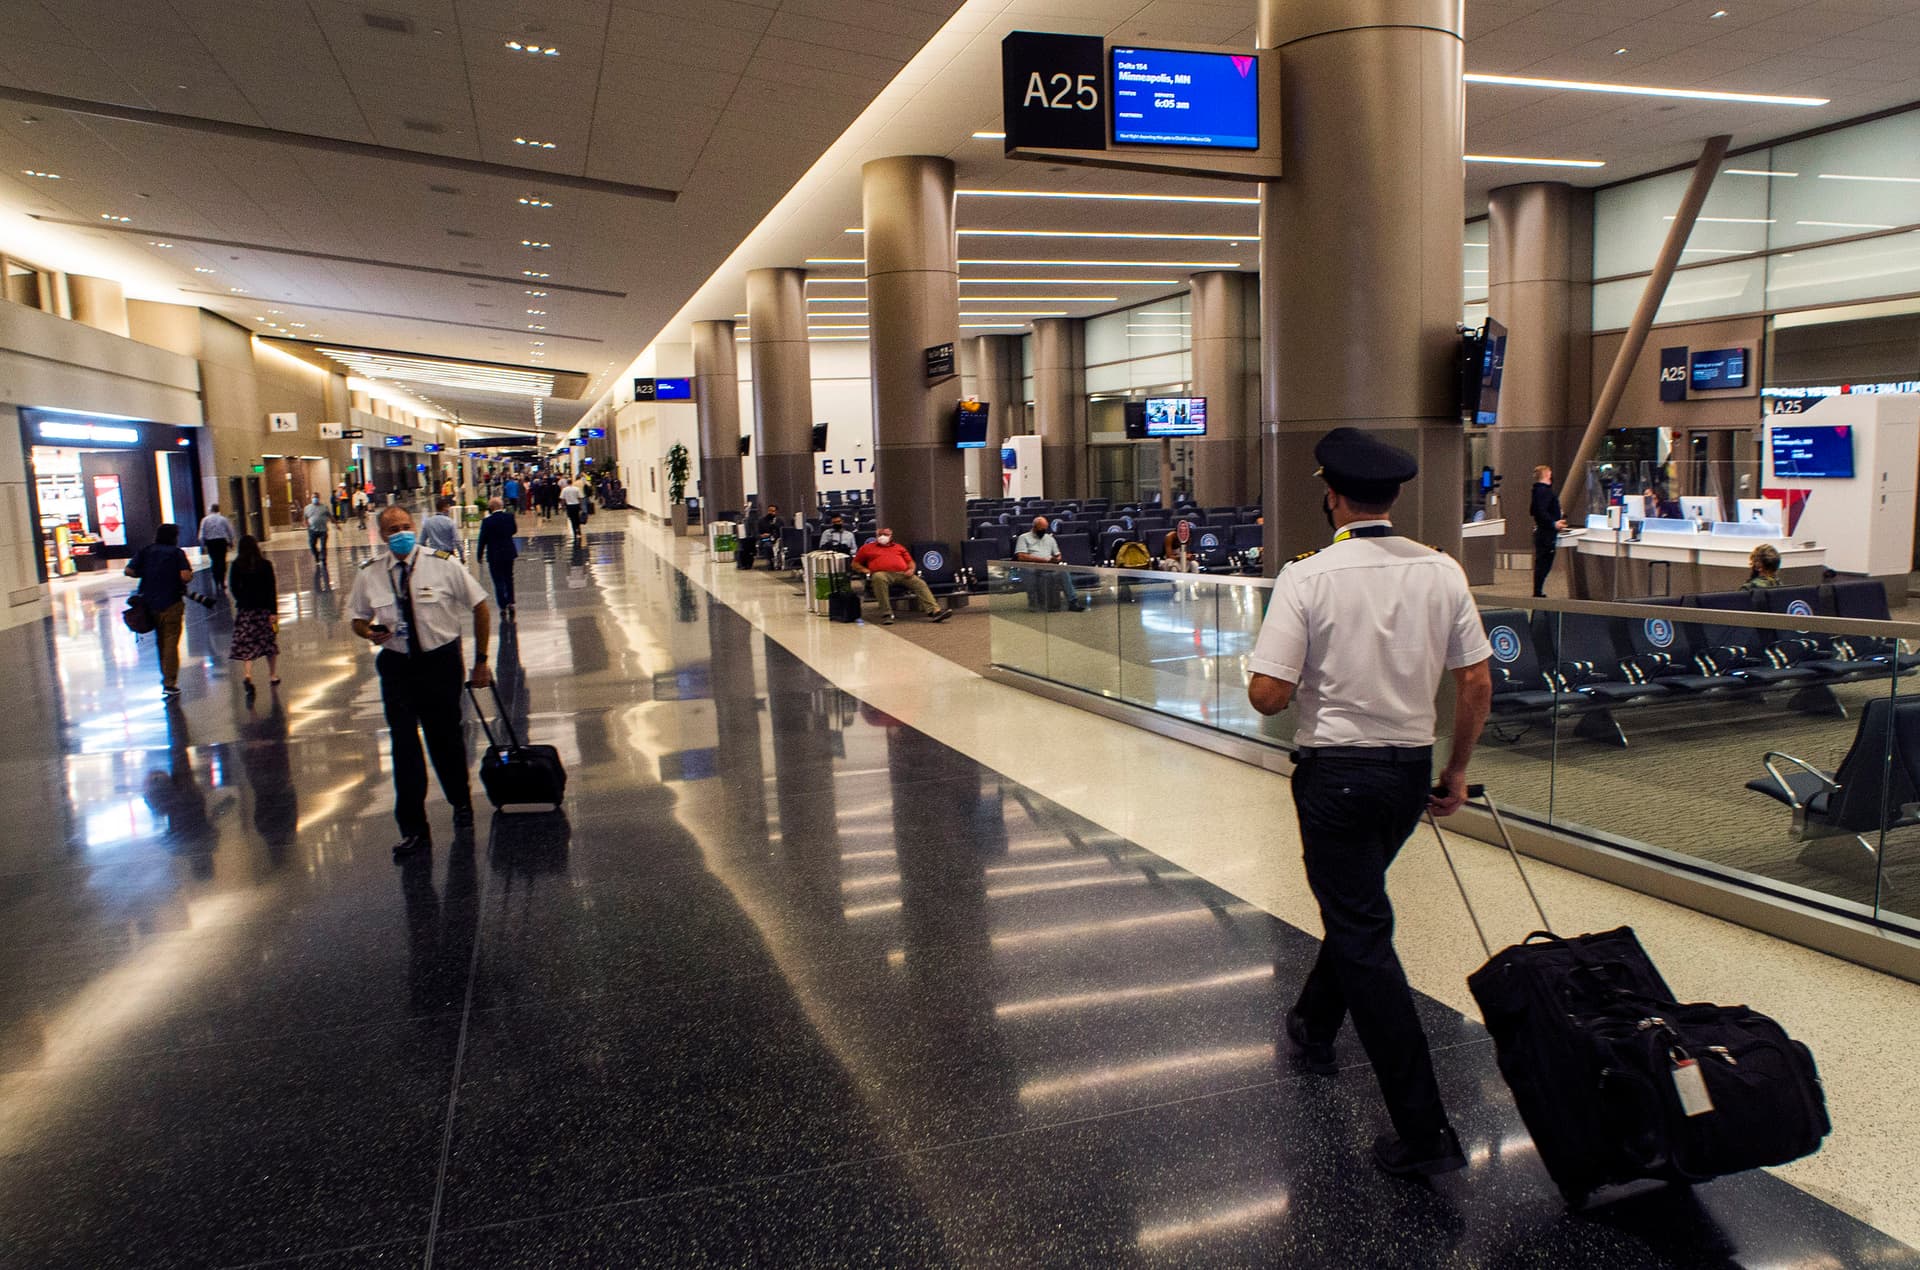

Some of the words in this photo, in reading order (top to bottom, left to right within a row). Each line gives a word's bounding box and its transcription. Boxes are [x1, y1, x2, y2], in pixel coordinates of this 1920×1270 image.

[1119, 71, 1173, 84] Minneapolis,
[1023, 72, 1098, 111] A25
[1154, 99, 1175, 108] 6:05
[1660, 365, 1687, 382] A25
[636, 385, 654, 394] A23
[1774, 400, 1802, 414] A25
[822, 458, 876, 474] ELT
